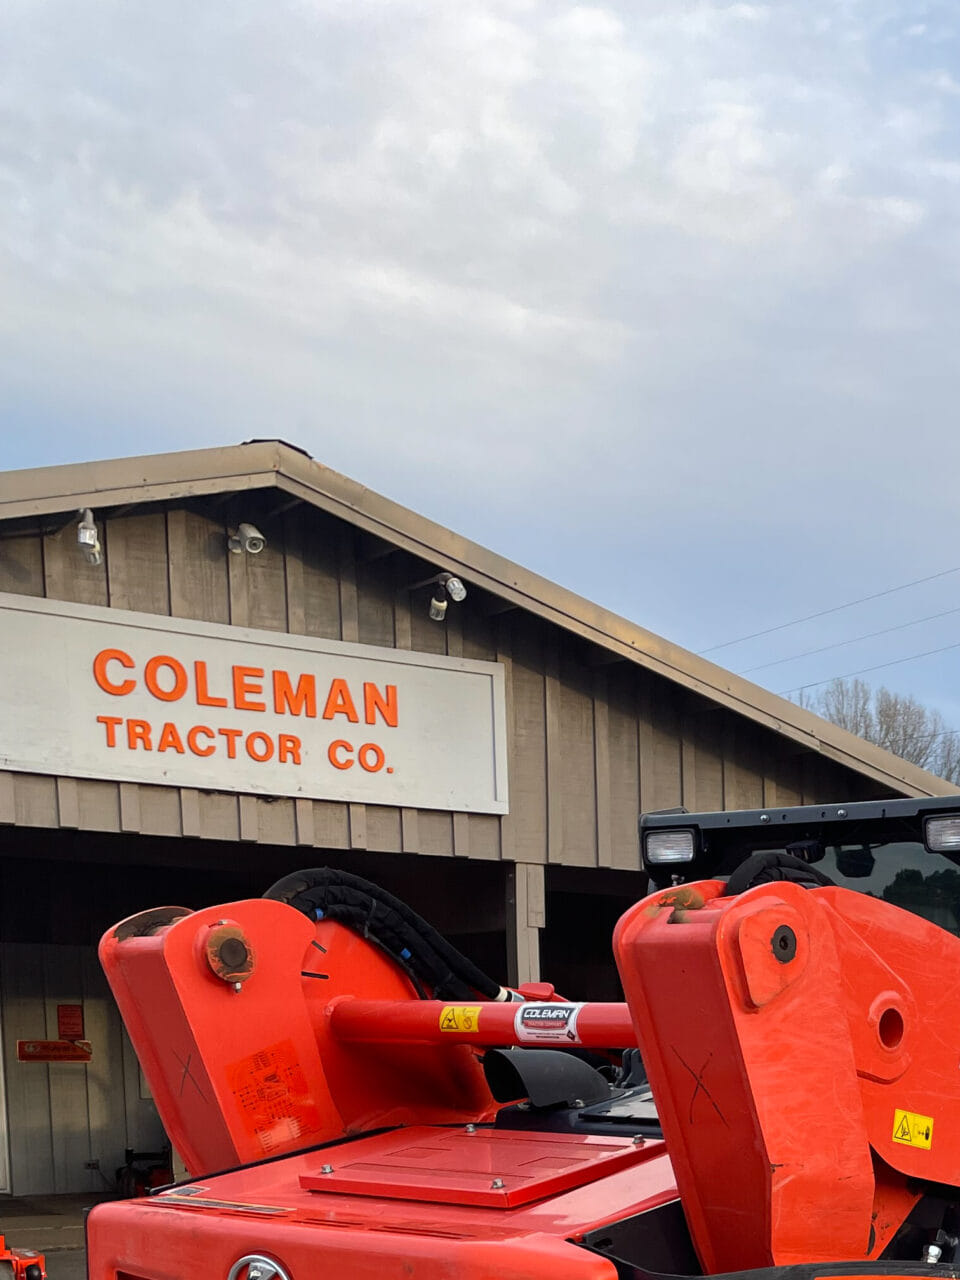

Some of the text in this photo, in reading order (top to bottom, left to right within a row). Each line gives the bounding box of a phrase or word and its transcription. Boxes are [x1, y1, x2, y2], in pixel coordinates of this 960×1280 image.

[93, 648, 398, 727] COLEMAN
[97, 715, 394, 774] TRACTOR CO.
[524, 1009, 570, 1018] COLEMAN
